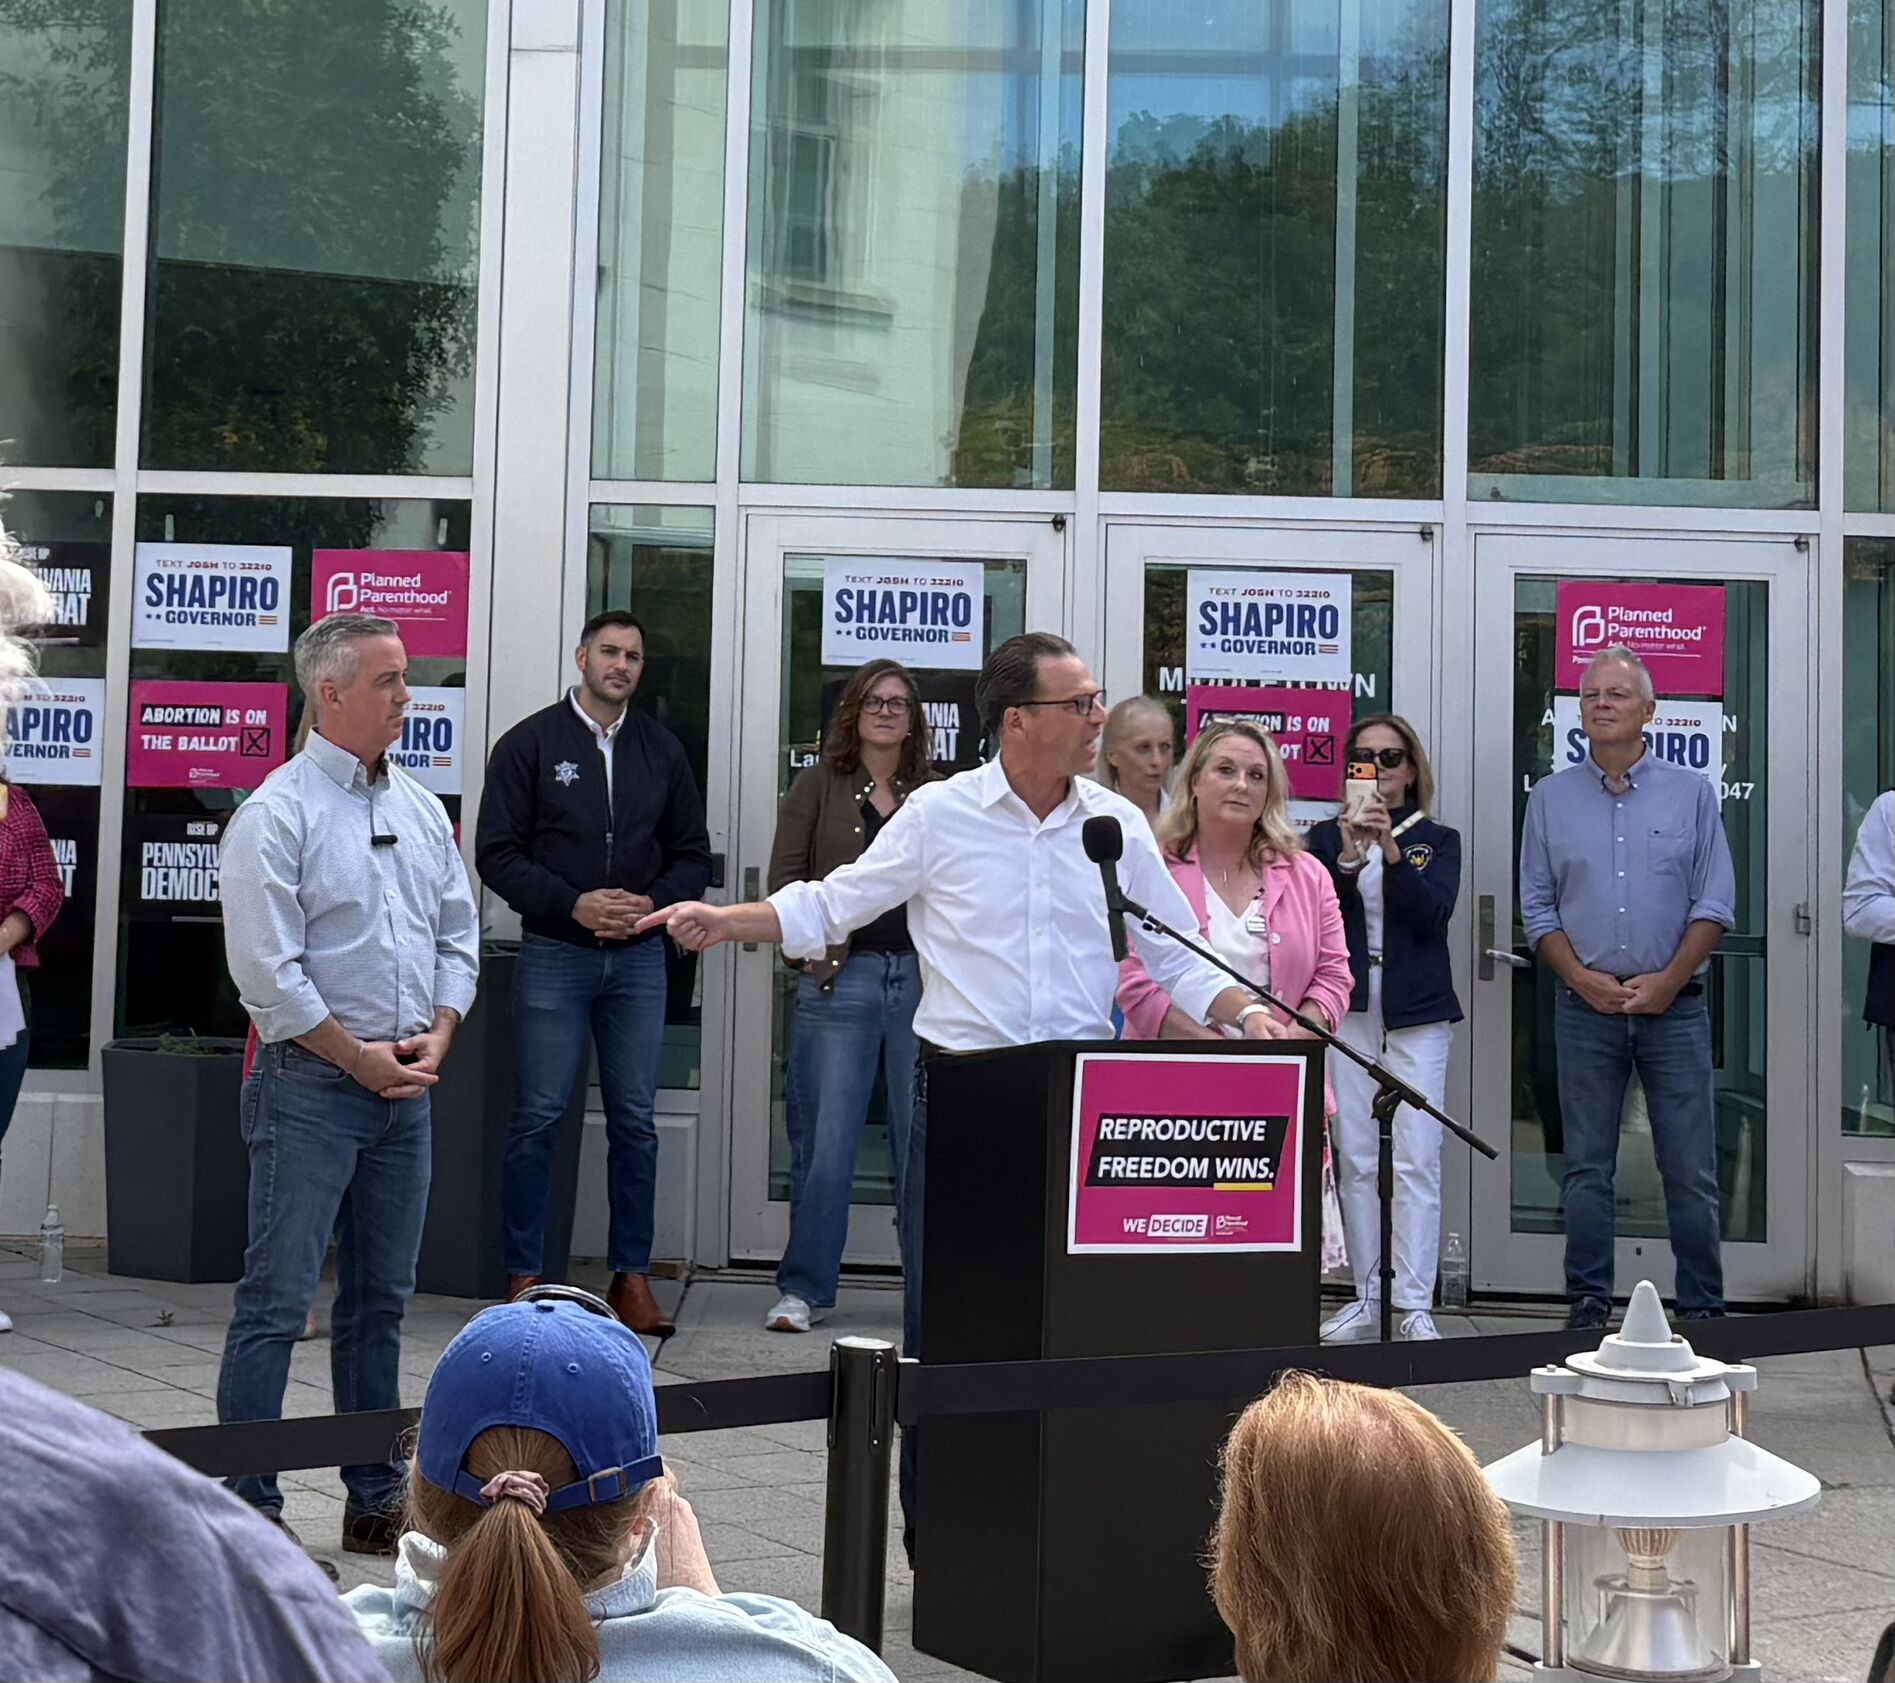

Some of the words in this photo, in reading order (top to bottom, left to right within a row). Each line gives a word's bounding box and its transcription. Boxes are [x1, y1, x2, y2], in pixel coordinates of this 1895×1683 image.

[187, 561, 218, 570] JOSH
[222, 562, 236, 570] TO
[361, 573, 421, 587] Planned
[845, 575, 872, 583] TEXT
[876, 576, 909, 585] JOSH
[914, 578, 926, 586] TO
[145, 573, 279, 611] SHAPIRO
[360, 589, 448, 604] Parenthood
[1209, 587, 1236, 596] TEXT
[1241, 588, 1274, 597] JOSH
[1279, 589, 1293, 597] TO
[835, 588, 972, 627] SHAPIRO
[1608, 606, 1673, 623] Planned
[165, 610, 256, 627] GOVERNOR
[1199, 601, 1339, 639] SHAPIRO
[856, 626, 949, 643] GOVERNOR
[1608, 623, 1702, 640] Parenthood
[1221, 639, 1316, 655] GOVERNOR
[141, 706, 221, 724] ABORTION
[226, 708, 240, 724] IS
[245, 709, 267, 725] ON
[1287, 715, 1302, 732] IS
[1307, 717, 1330, 733] ON
[6, 706, 93, 743] APIRO
[4, 743, 71, 759] VERNOR
[141, 734, 173, 750] THE
[178, 736, 239, 752] BALLOT
[141, 867, 219, 902] DEMOC
[1099, 1118, 1267, 1142] REPRODUCTIVE
[1098, 1156, 1209, 1179] FREEDOM
[1215, 1157, 1275, 1179] WINS.
[1123, 1218, 1147, 1233] WE
[1151, 1219, 1205, 1233] DECIDE
